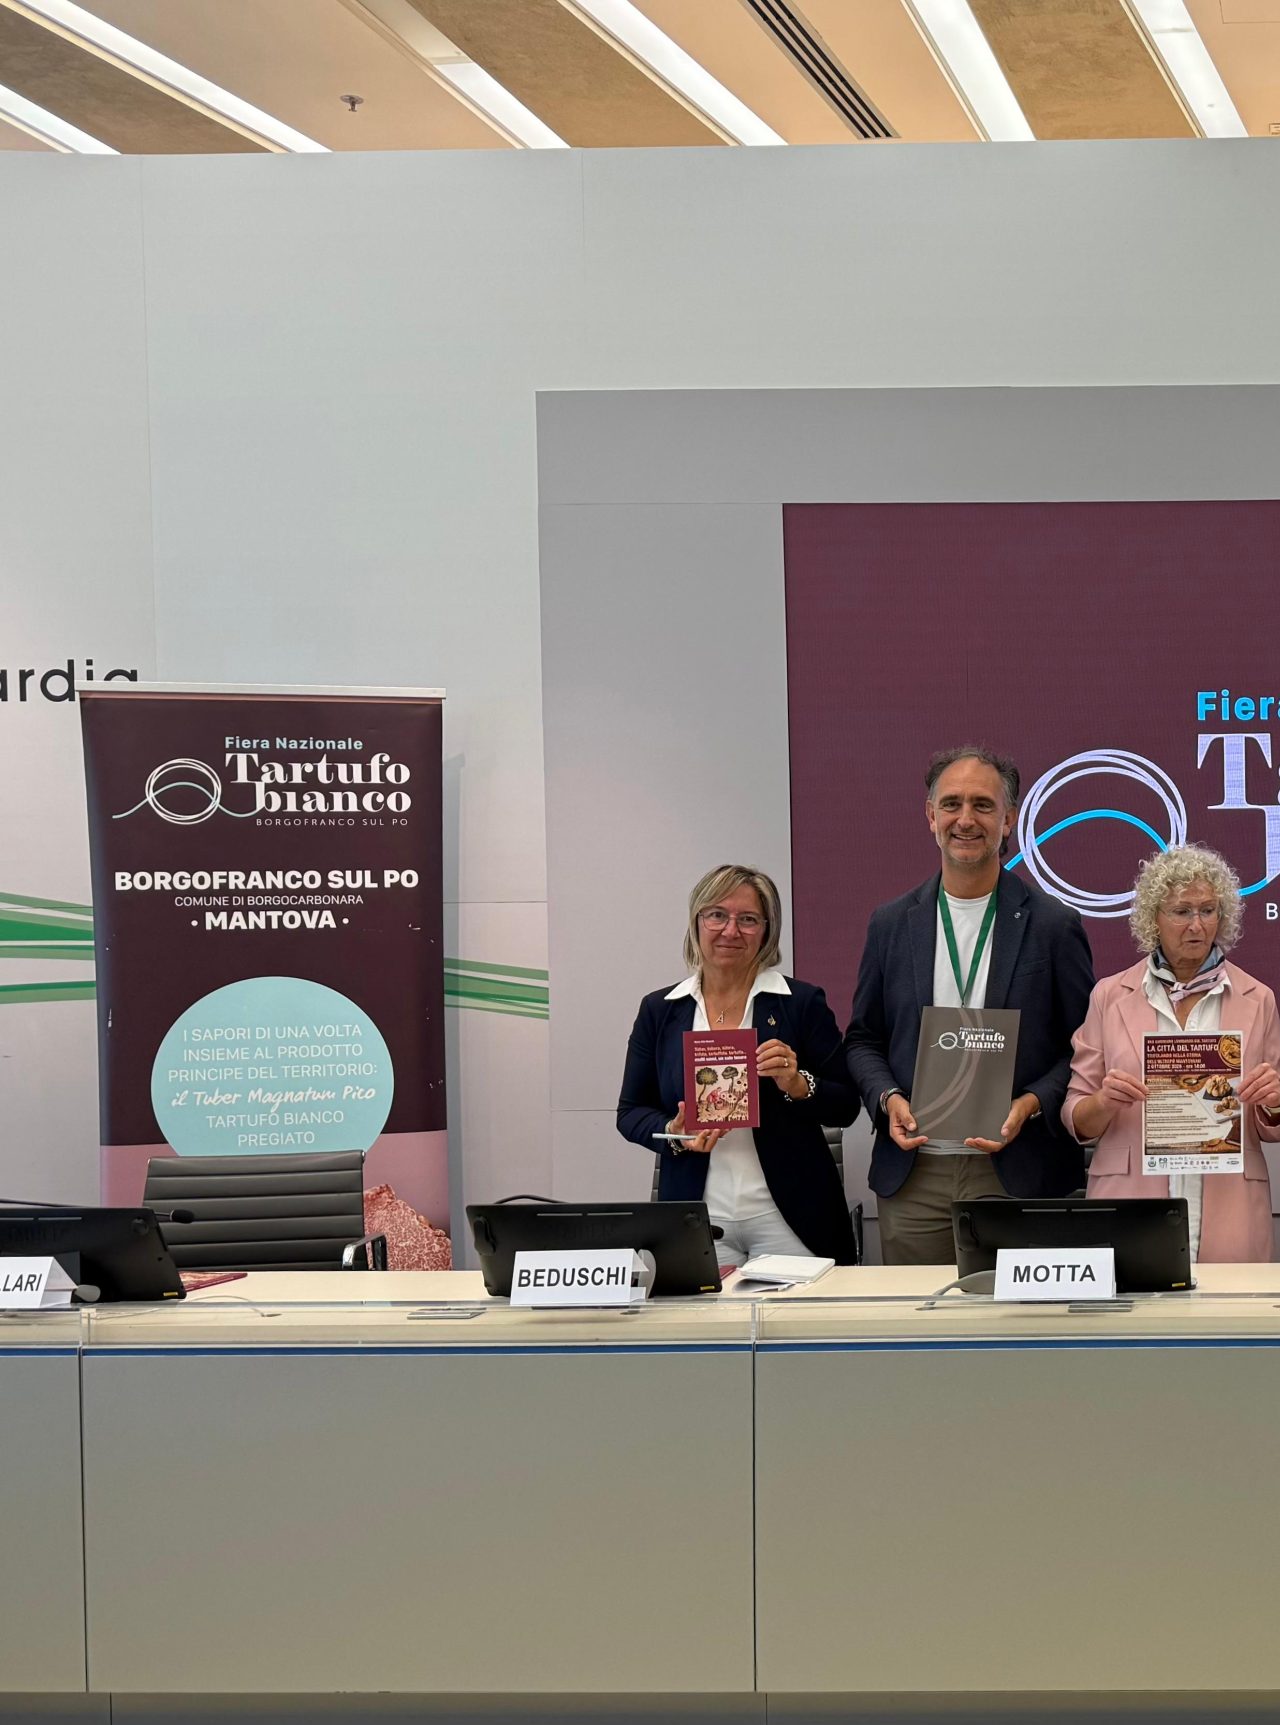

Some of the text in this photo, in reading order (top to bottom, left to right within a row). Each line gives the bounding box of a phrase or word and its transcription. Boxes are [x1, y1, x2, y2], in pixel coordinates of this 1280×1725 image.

[0, 659, 137, 702] rdi
[225, 736, 363, 750] Fiera Nazionale
[225, 753, 411, 785] Tartufo
[255, 781, 412, 812] bianco
[256, 818, 409, 826] BORGOFRANCO SUL PO
[115, 869, 419, 891] BORGOFRANCO SUL PO
[174, 895, 364, 907] COMUNE DI BORGOCARBONARA
[205, 910, 336, 930] MANTOVA
[192, 1028, 250, 1041] SAPORI
[255, 1027, 271, 1040] DI
[275, 1026, 309, 1039] UNA
[313, 1024, 362, 1038] VOLTA
[184, 1044, 363, 1062] INSIEME AL PRODOTTO
[168, 1063, 378, 1082] PRINCIPE DEL TERRITORIO:
[171, 1086, 376, 1112] il Tuber Magnatum Pico
[206, 1110, 344, 1128] TARTUFO BIANCO
[238, 1131, 315, 1147] PREGIATO
[0, 1274, 42, 1292] LARI
[518, 1266, 625, 1288] BEDUSCHI
[1013, 1264, 1096, 1283] MOTTA
